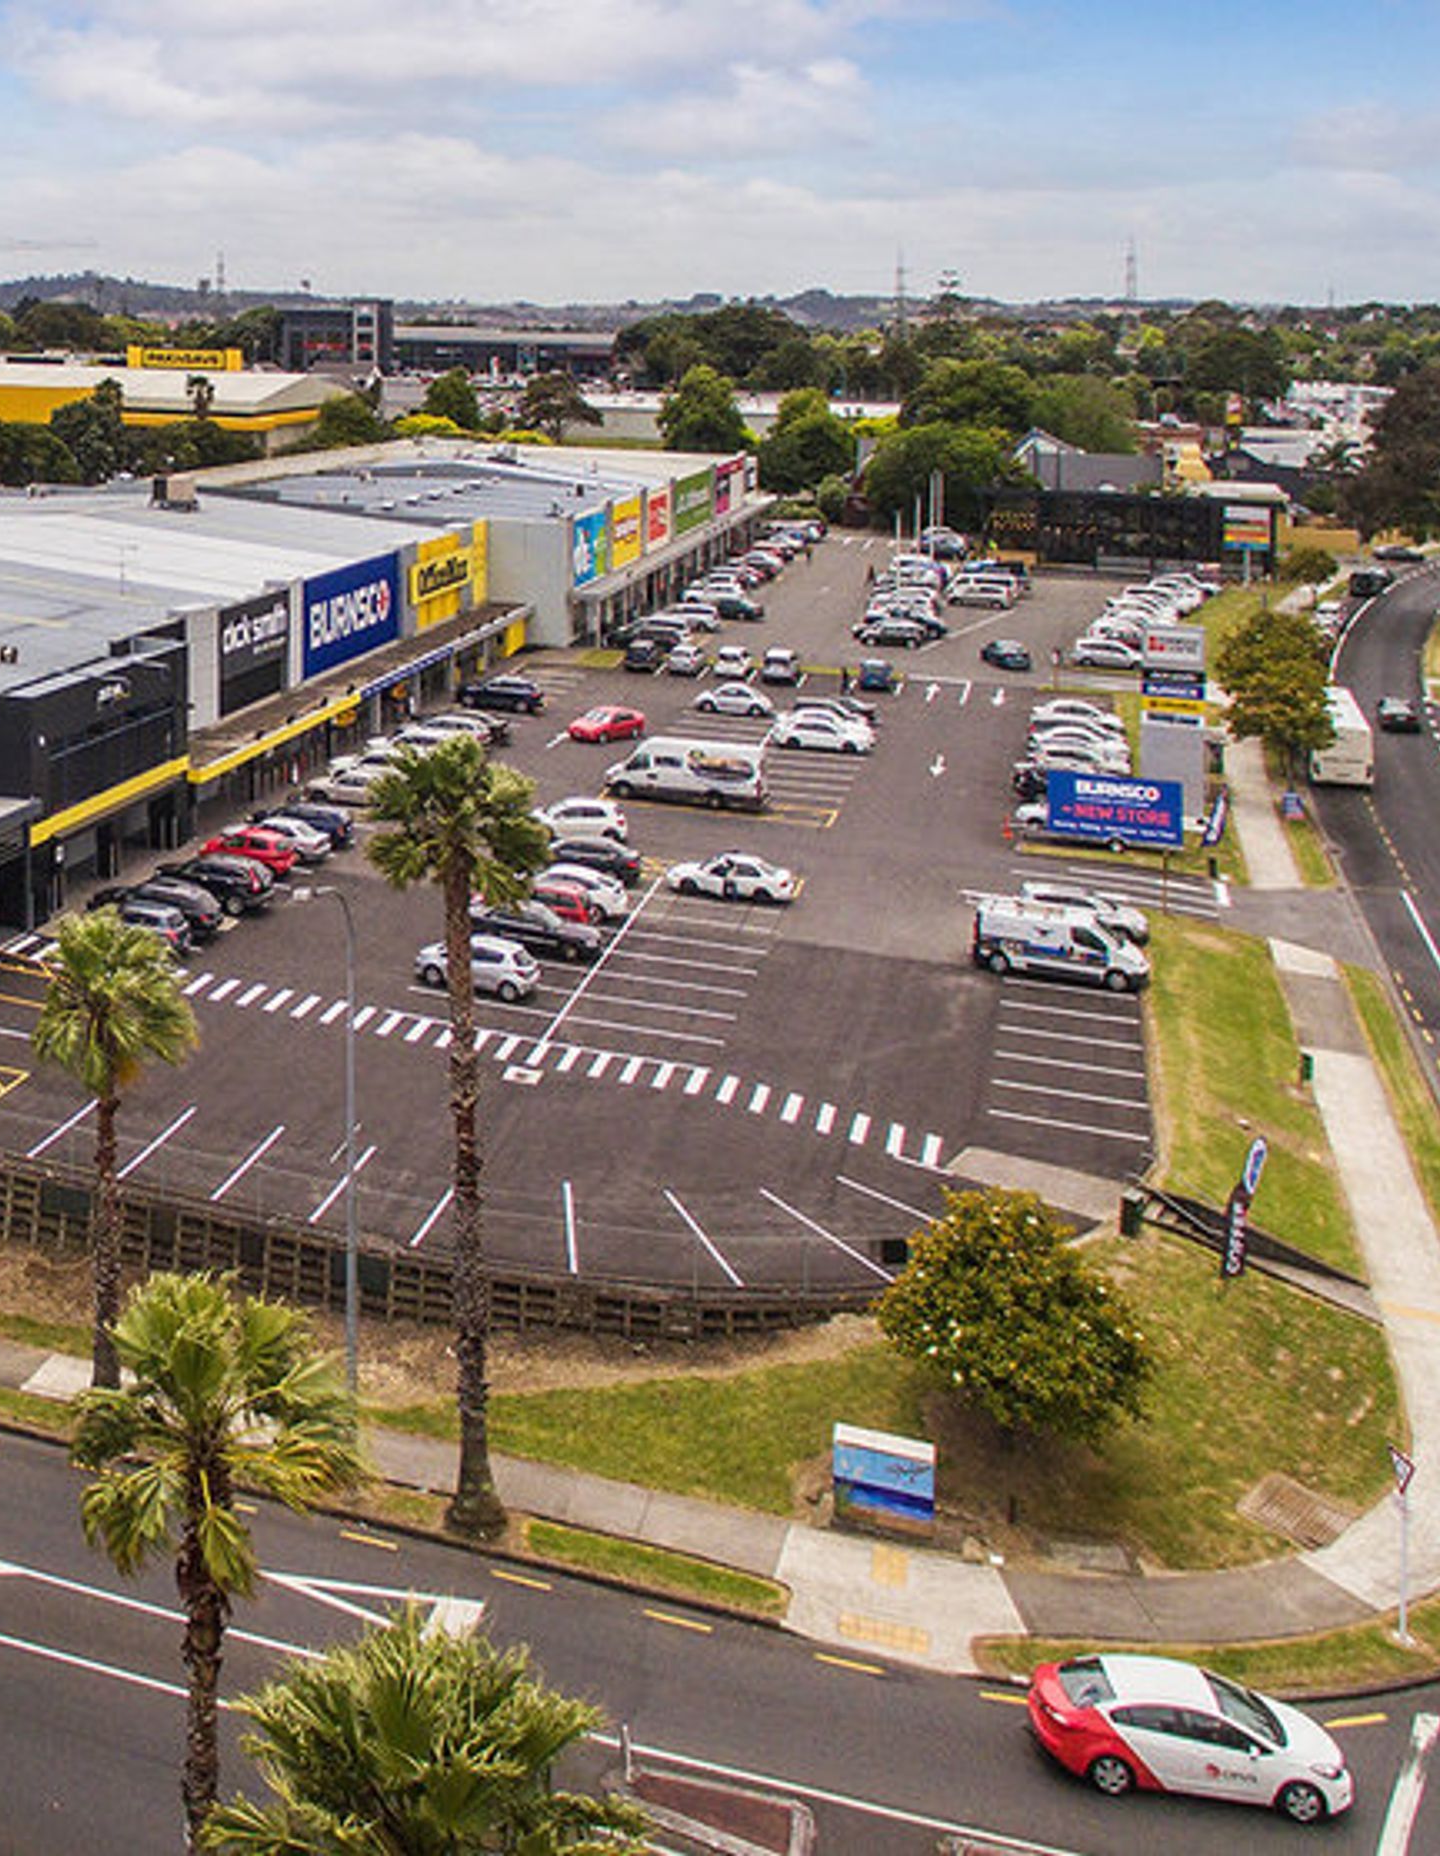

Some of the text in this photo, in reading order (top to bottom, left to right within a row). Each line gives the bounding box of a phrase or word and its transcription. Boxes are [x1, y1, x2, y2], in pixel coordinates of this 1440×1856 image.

[252, 602, 288, 642] smith
[309, 578, 391, 651] BURNSCO
[1075, 804, 1170, 826] NEW STORE
